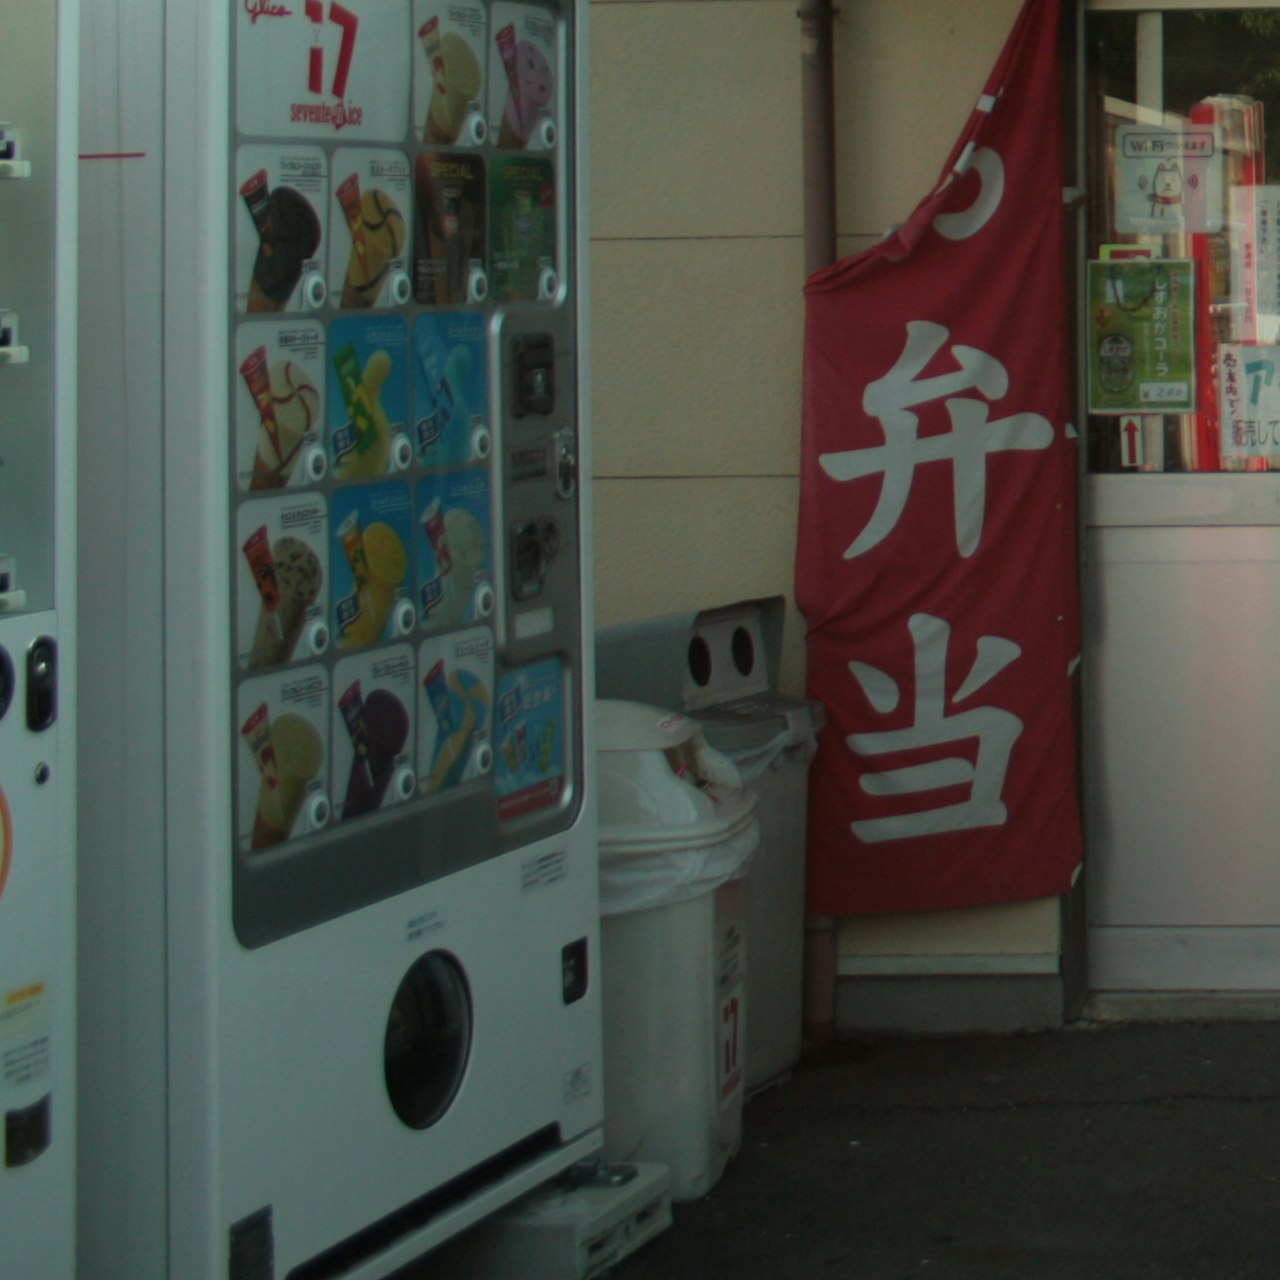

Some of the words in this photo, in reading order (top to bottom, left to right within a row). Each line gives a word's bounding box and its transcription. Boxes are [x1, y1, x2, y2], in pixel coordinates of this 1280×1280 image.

[1152, 278, 1169, 376] しずおかコーラ
